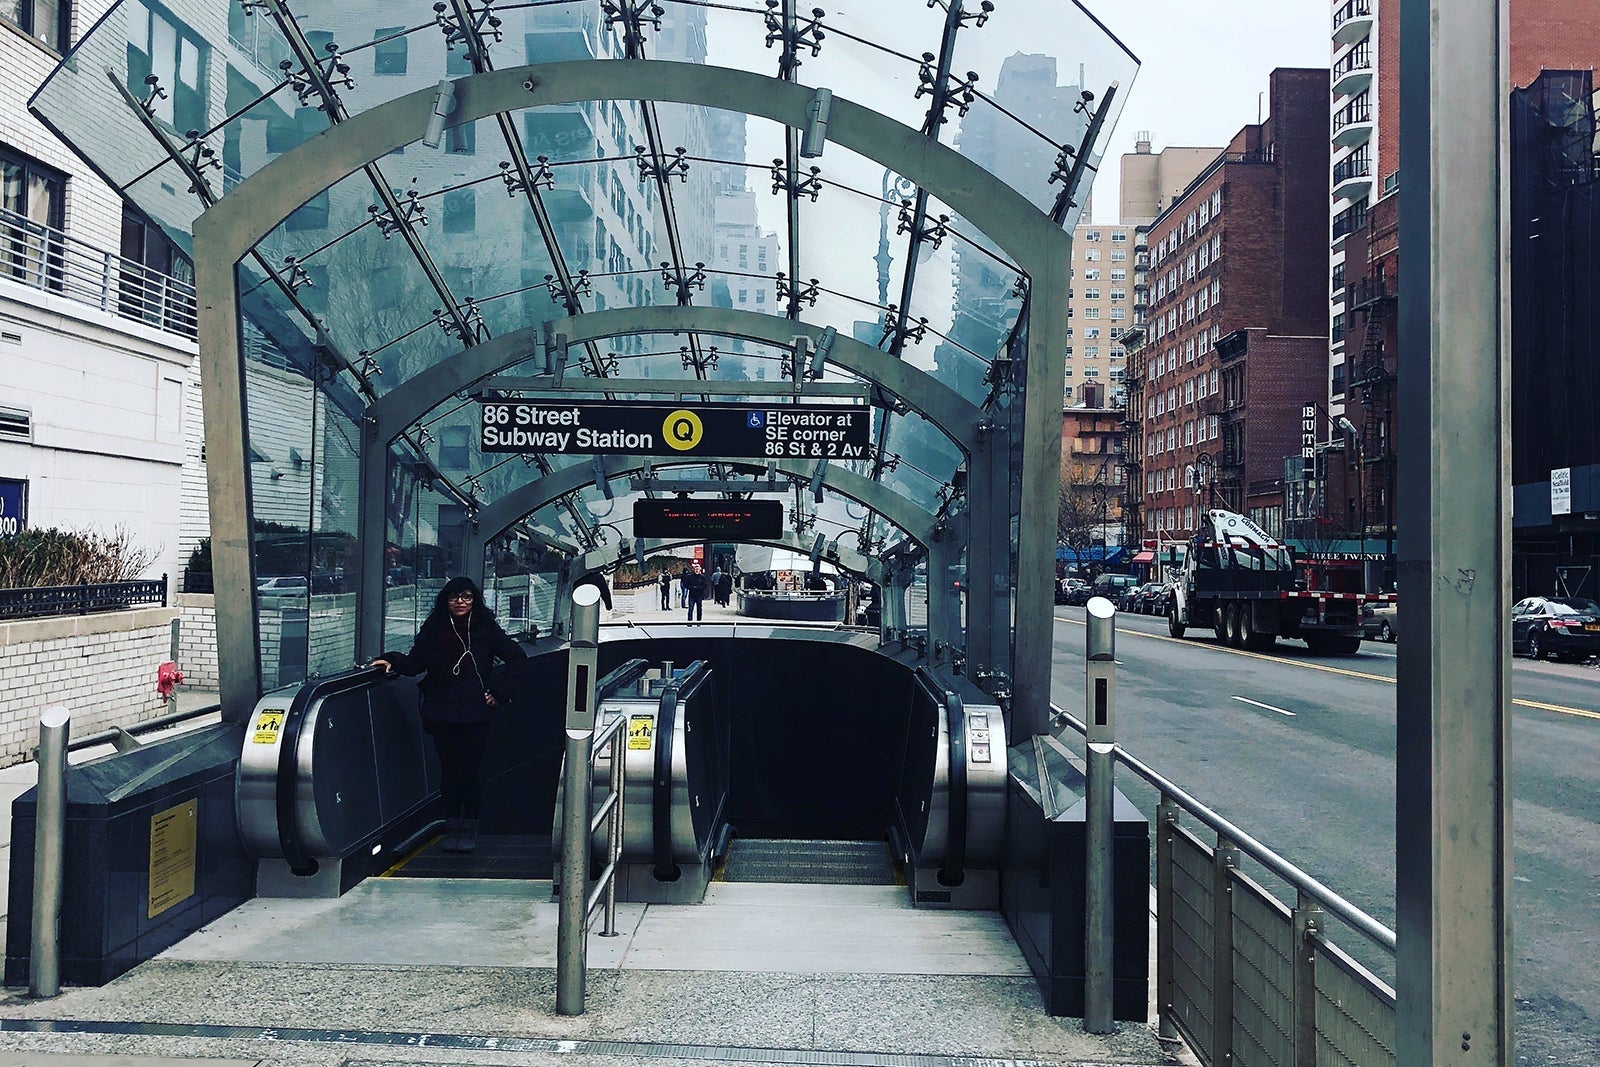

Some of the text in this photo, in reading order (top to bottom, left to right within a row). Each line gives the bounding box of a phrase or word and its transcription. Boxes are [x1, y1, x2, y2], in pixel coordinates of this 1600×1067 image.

[483, 405, 581, 426] 86 Street
[766, 411, 852, 427] Elevator at
[672, 417, 694, 442] Q
[765, 426, 846, 442] SE corner
[483, 426, 653, 452] Subway Station
[765, 441, 863, 457] 86 St & 2 Av
